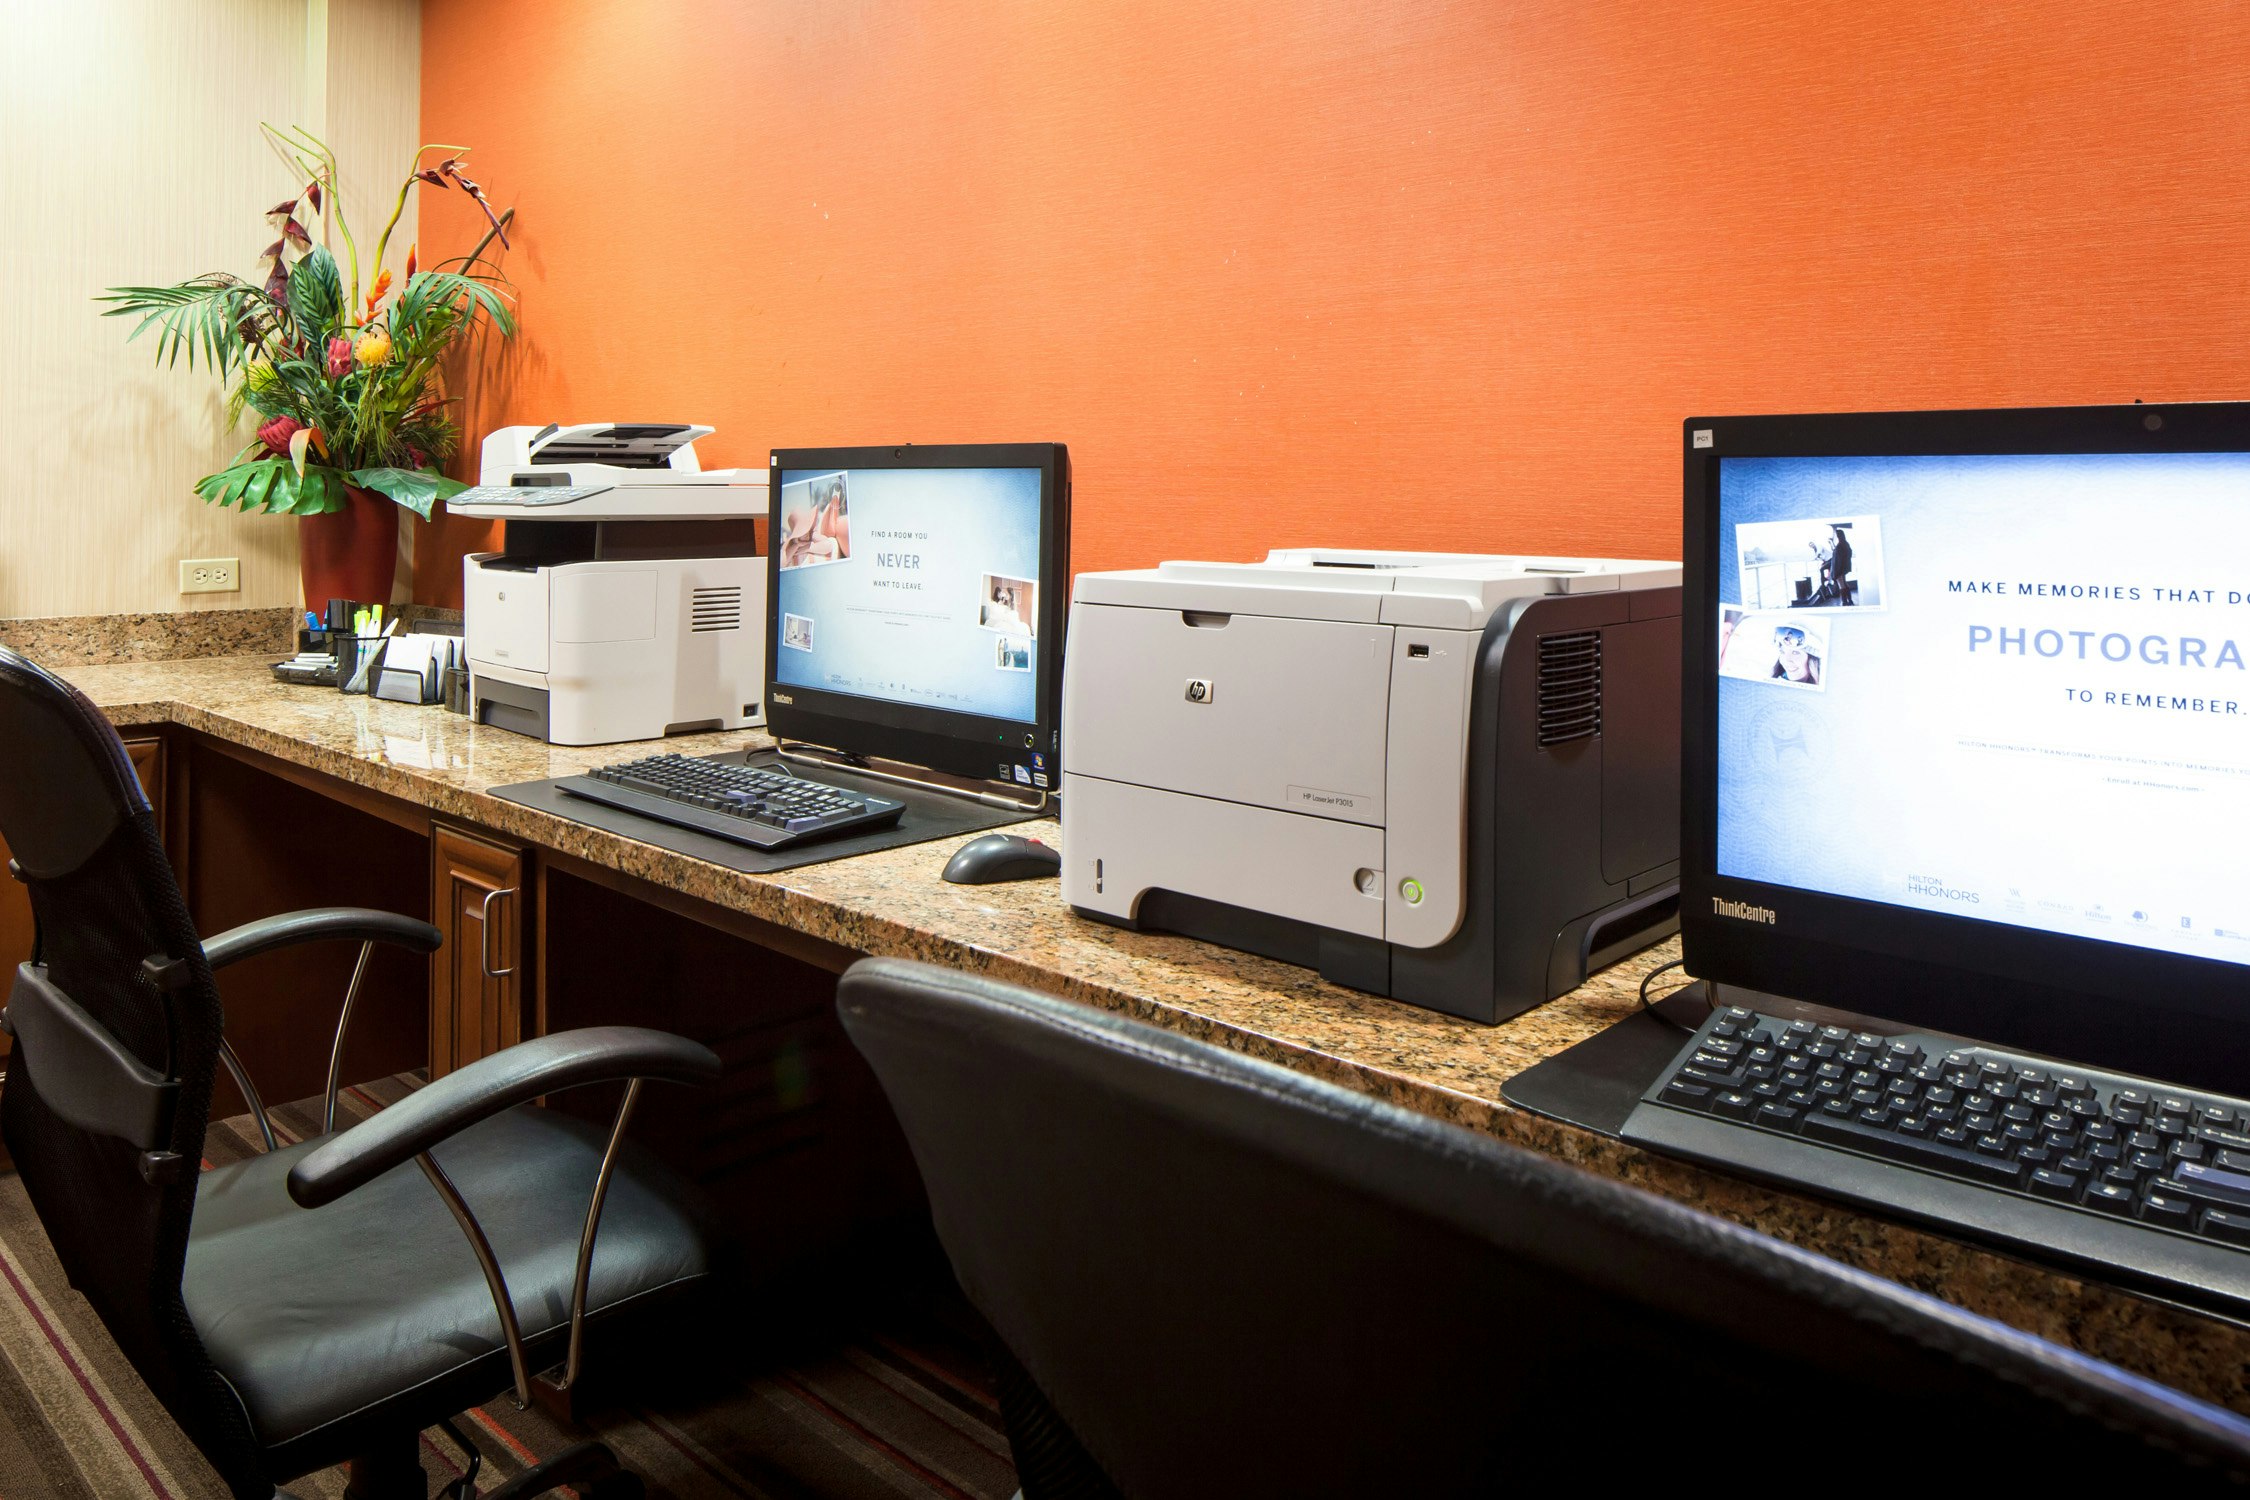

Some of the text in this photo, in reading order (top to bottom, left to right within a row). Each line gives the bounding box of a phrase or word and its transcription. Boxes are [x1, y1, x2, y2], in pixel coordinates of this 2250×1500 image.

[915, 532, 928, 540] YOU
[877, 552, 920, 570] NEVER
[902, 582, 924, 590] LEAVE.
[1948, 580, 2006, 594] MAKE
[2018, 583, 2140, 600] MEMORIES
[2153, 588, 2215, 604] THAT
[1968, 624, 2246, 670] PHOTOGRA
[1190, 680, 1206, 701] hp
[2065, 688, 2248, 716] TO REMEMBER.
[2040, 748, 2096, 760] TRANSFORMS
[2126, 757, 2158, 766] POINTS
[2186, 763, 2236, 774] MEMORIES
[1335, 798, 1354, 808] P3015
[1908, 874, 1943, 886] HILTON
[1908, 882, 1980, 904] HHONORS
[1712, 896, 1776, 925] ThinkCentre
[2084, 910, 2112, 921] Hilton
[2012, 1124, 2022, 1132] K
